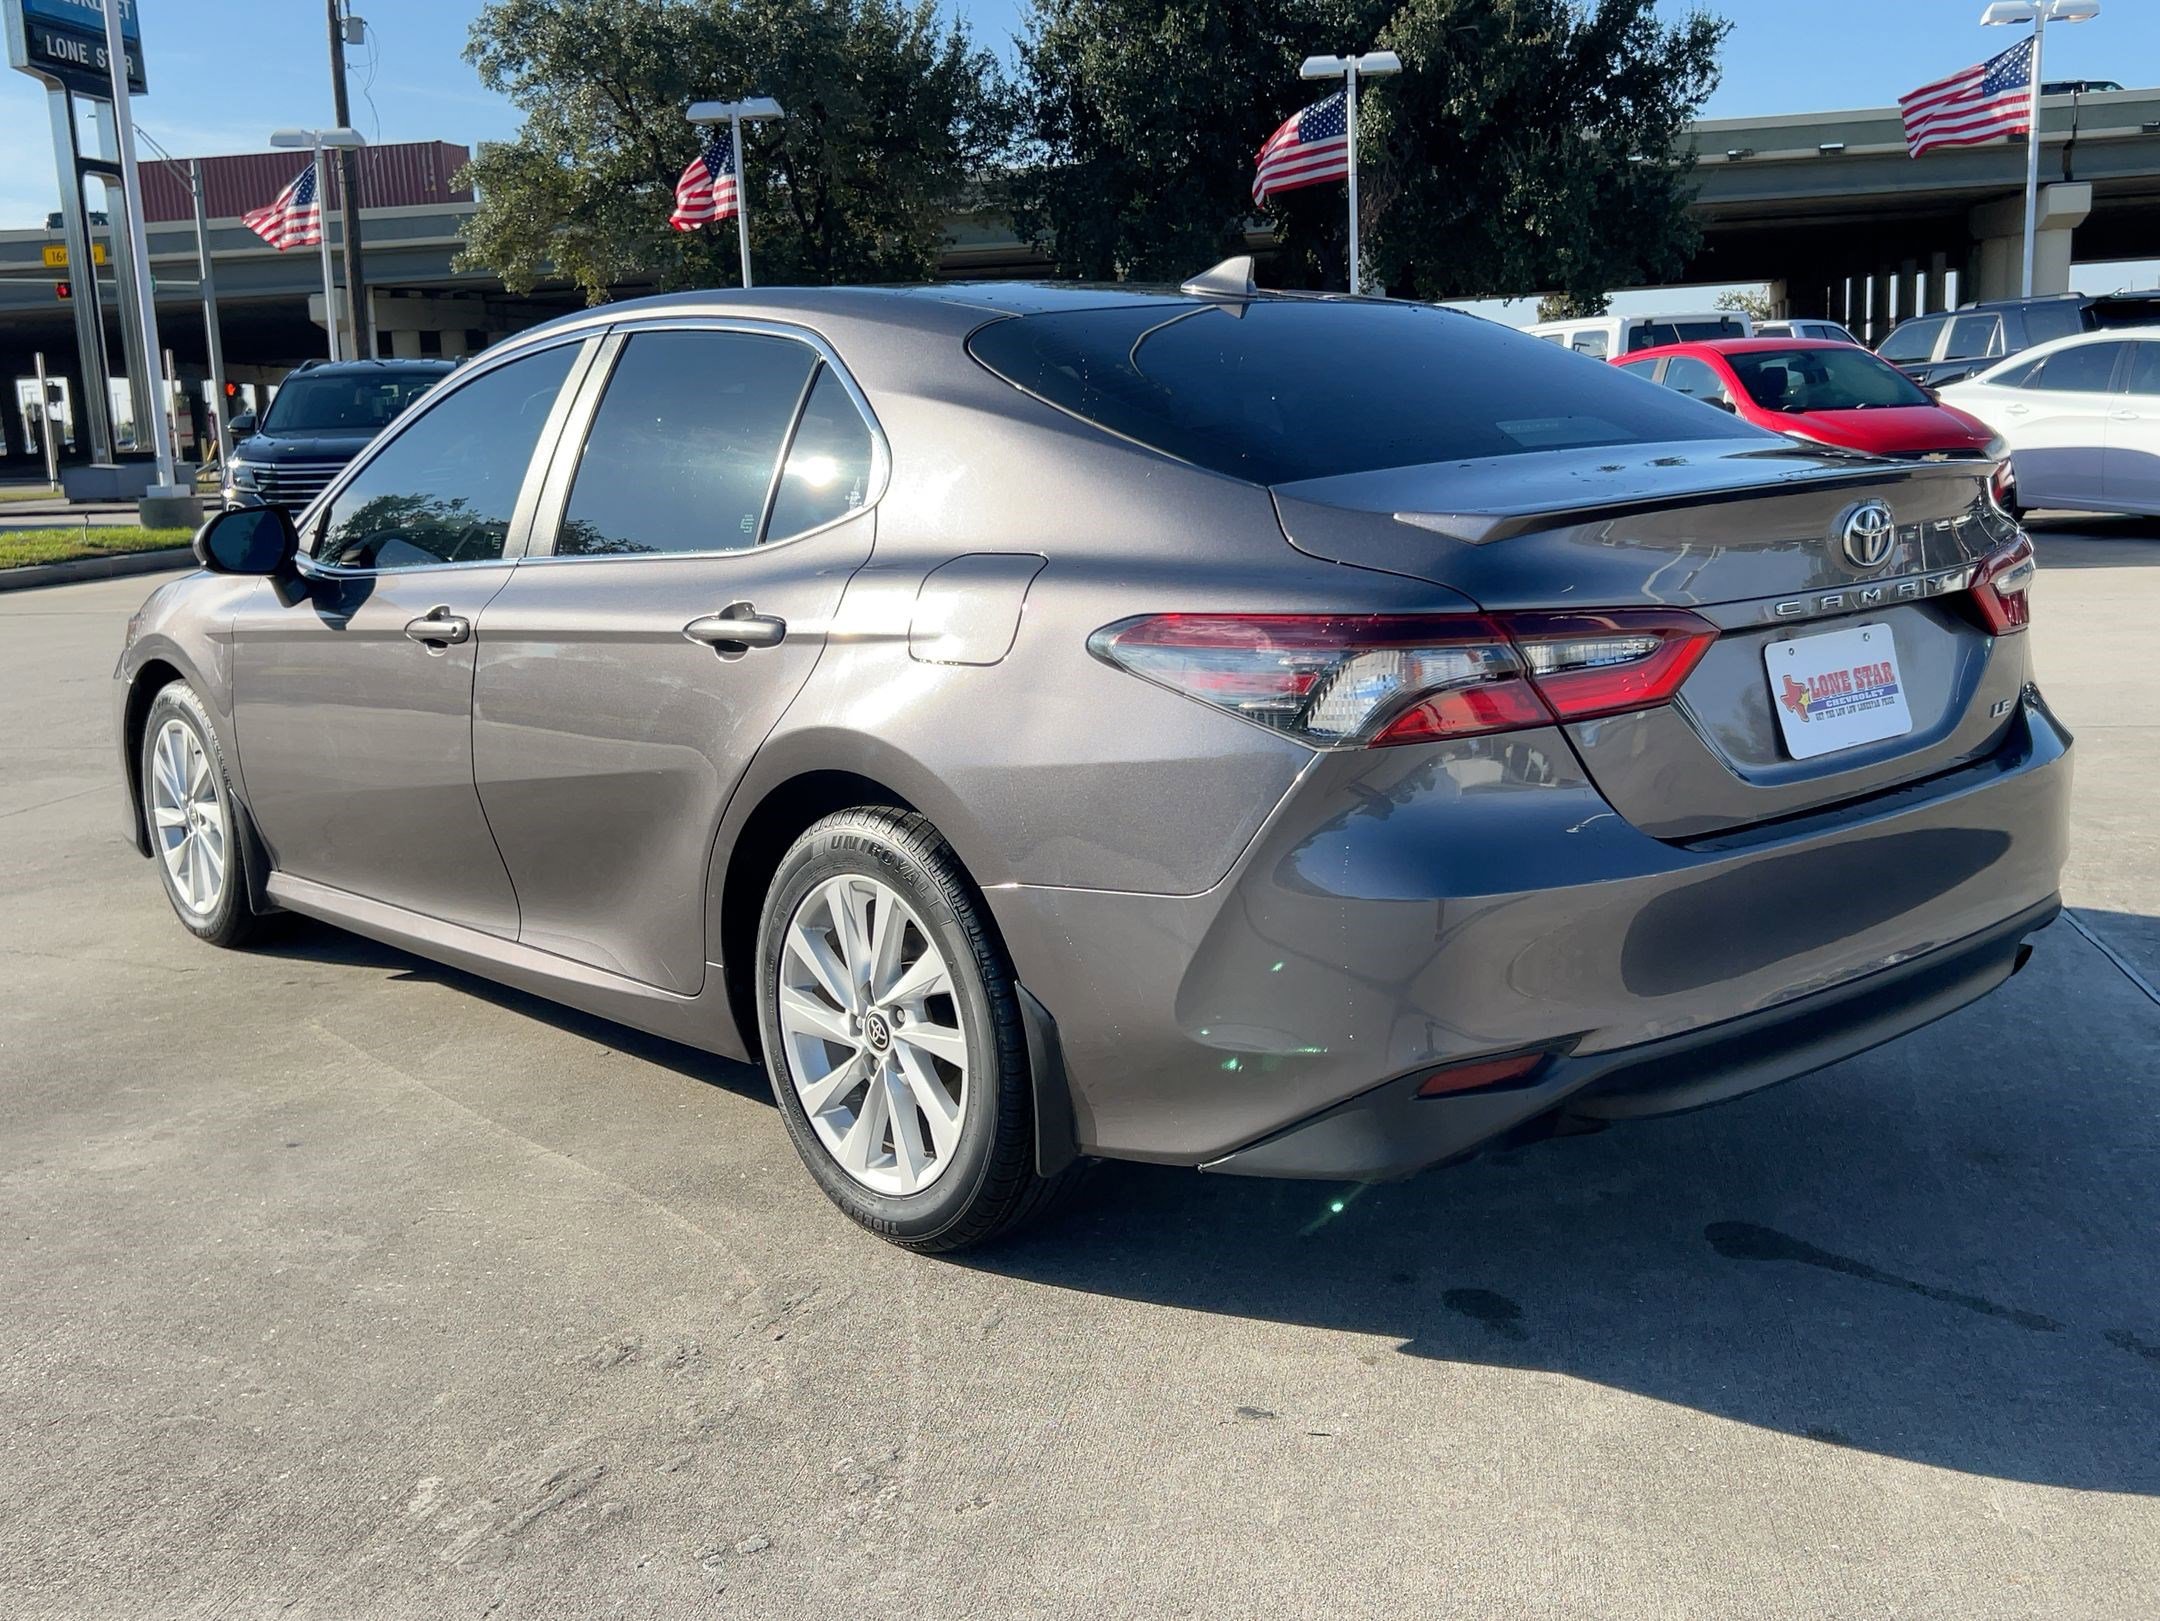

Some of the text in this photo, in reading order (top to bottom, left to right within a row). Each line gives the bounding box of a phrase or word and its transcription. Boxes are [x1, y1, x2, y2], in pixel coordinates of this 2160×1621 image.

[45, 34, 135, 75] LONE SR
[1807, 661, 1896, 699] LONE STAR
[1825, 688, 1885, 708] CHEVROLET
[830, 835, 931, 899] UNIROYAL
